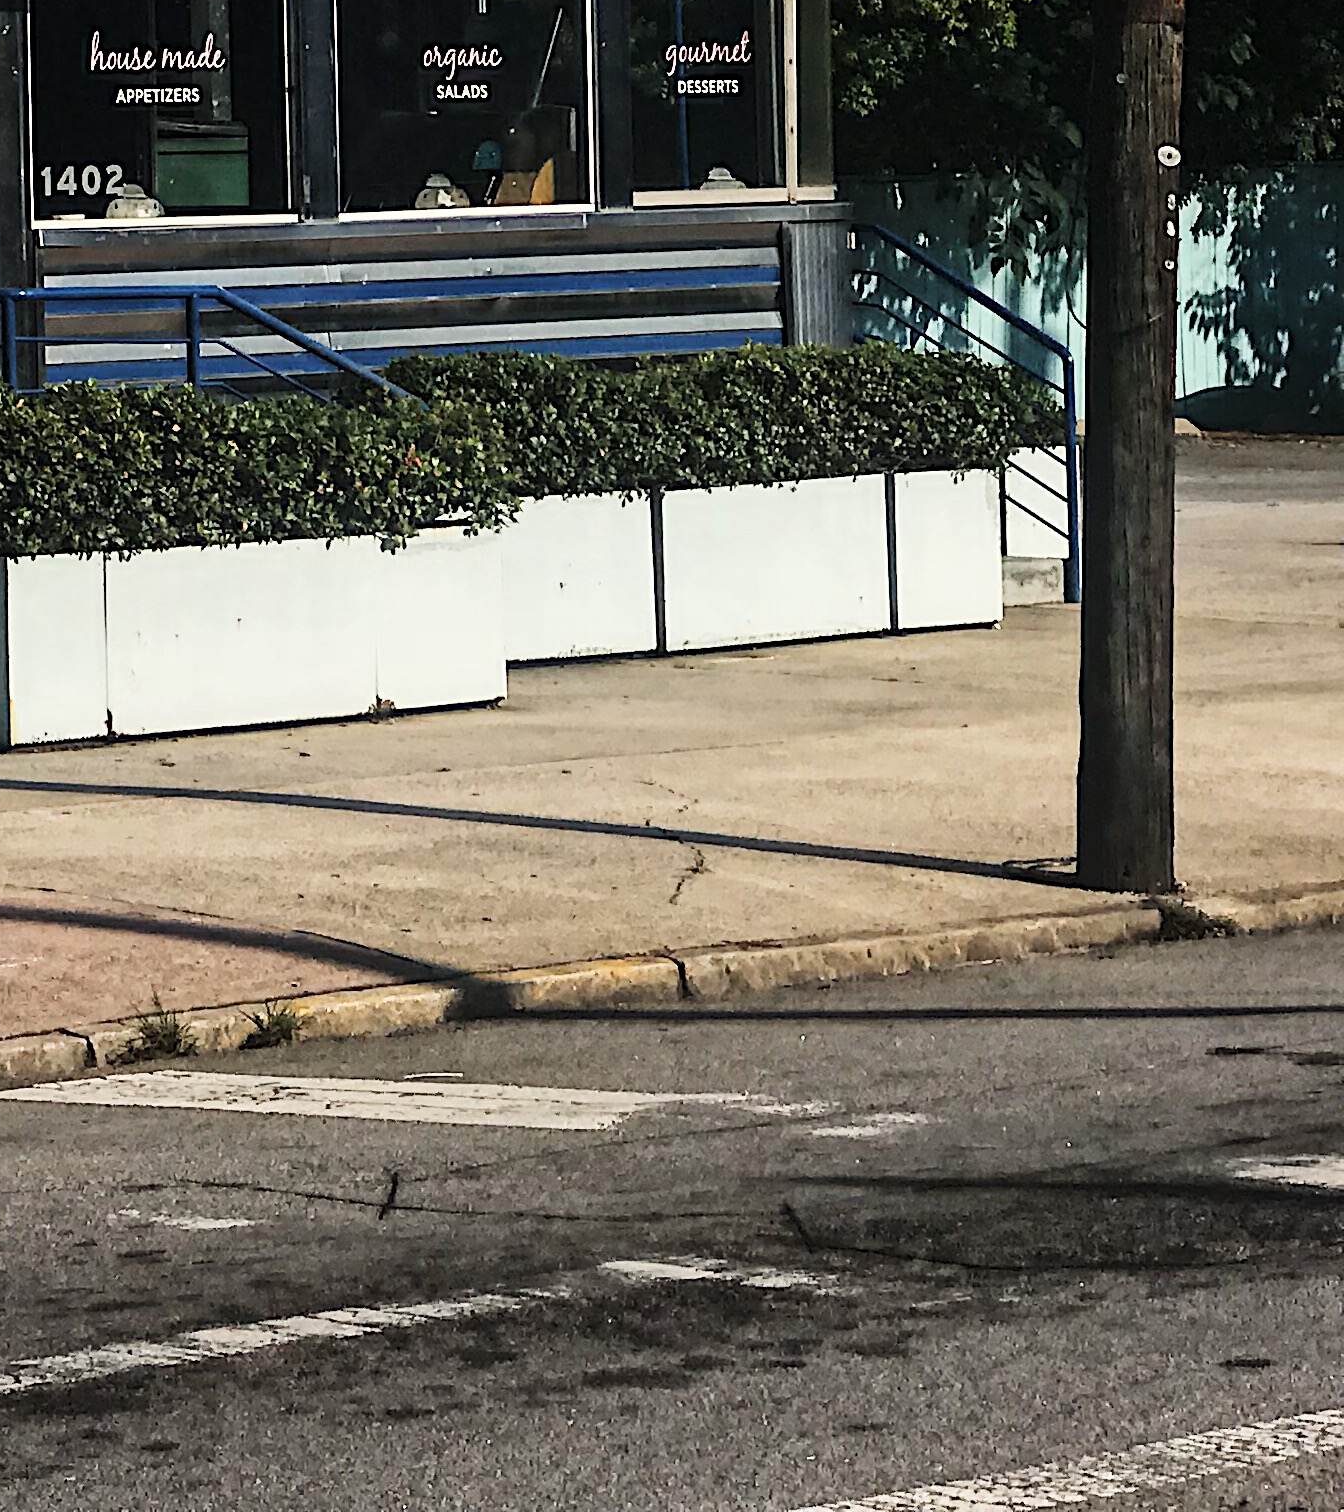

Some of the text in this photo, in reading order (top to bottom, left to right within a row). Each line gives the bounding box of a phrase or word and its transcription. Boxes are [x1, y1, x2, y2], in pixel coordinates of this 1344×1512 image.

[89, 30, 227, 72] house made
[423, 44, 503, 81] organic
[665, 30, 752, 77] gourmet
[115, 87, 201, 104] APPETIZERS
[436, 84, 489, 100] SALADS
[677, 79, 739, 94] DESSERTS
[40, 164, 126, 197] 1402
